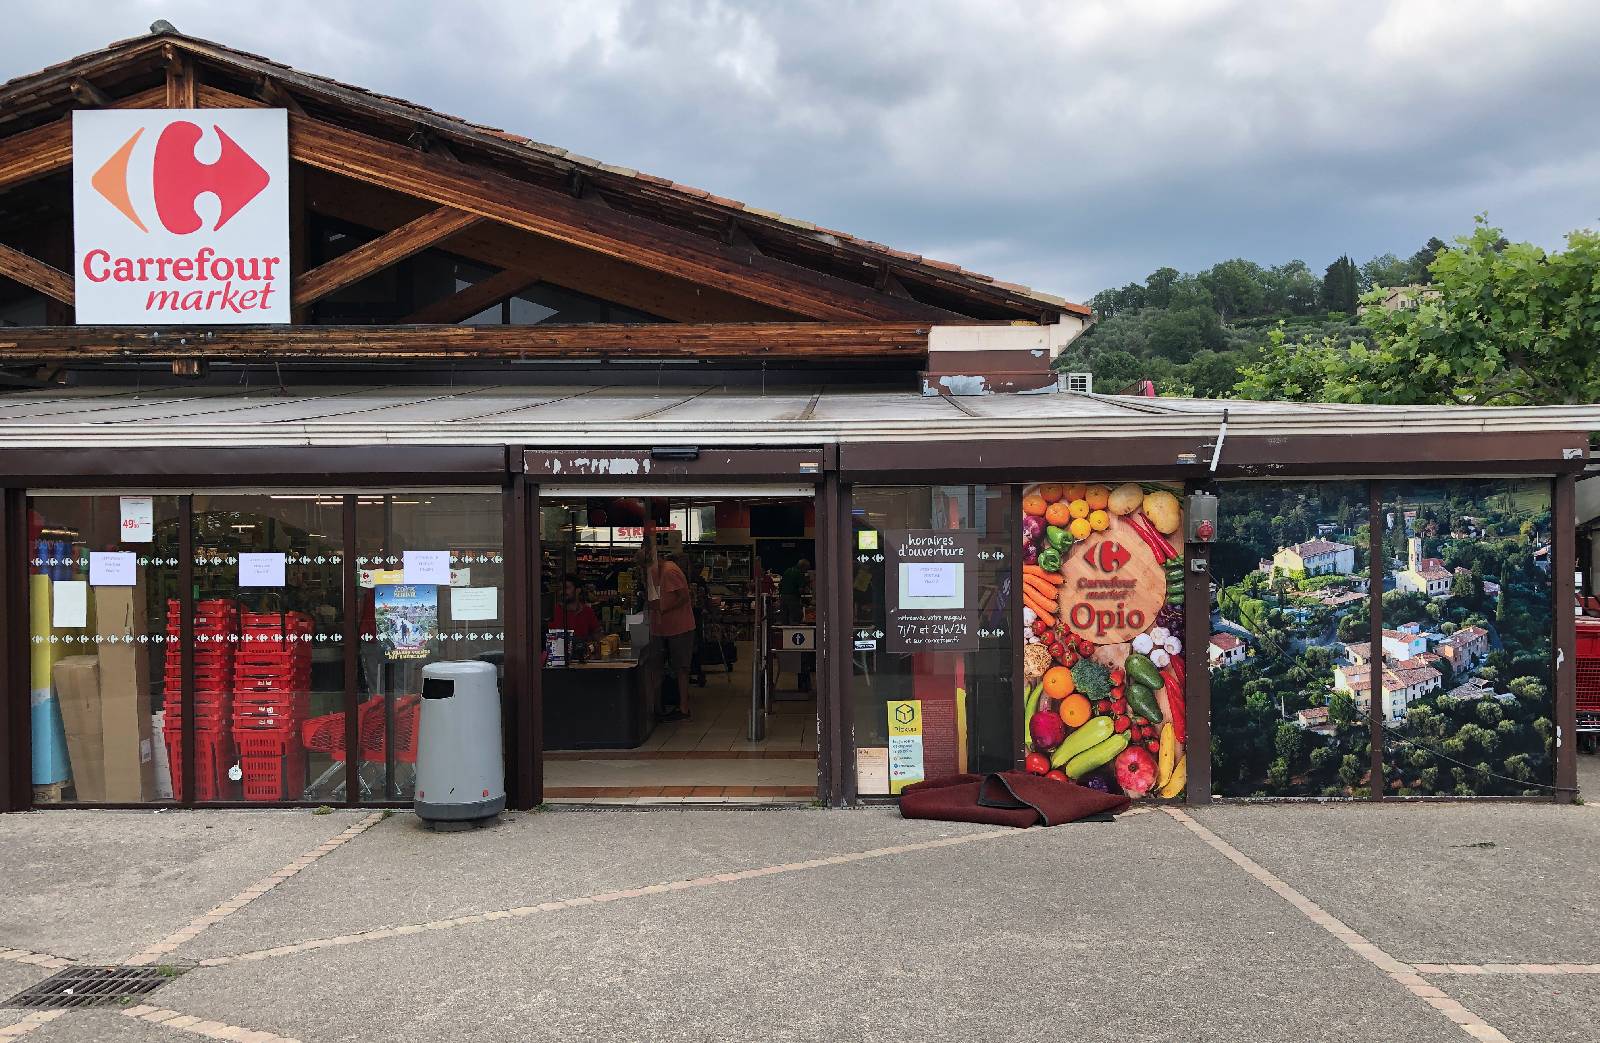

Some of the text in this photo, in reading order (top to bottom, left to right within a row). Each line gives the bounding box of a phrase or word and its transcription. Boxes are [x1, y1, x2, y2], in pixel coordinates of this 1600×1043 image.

[83, 247, 280, 283] Carrefour
[145, 281, 275, 313] market
[898, 543, 964, 557] d'ouverture
[908, 533, 954, 546] horaires
[897, 624, 917, 638] 7j/7
[919, 624, 929, 634] et
[1071, 602, 1145, 637] Opio
